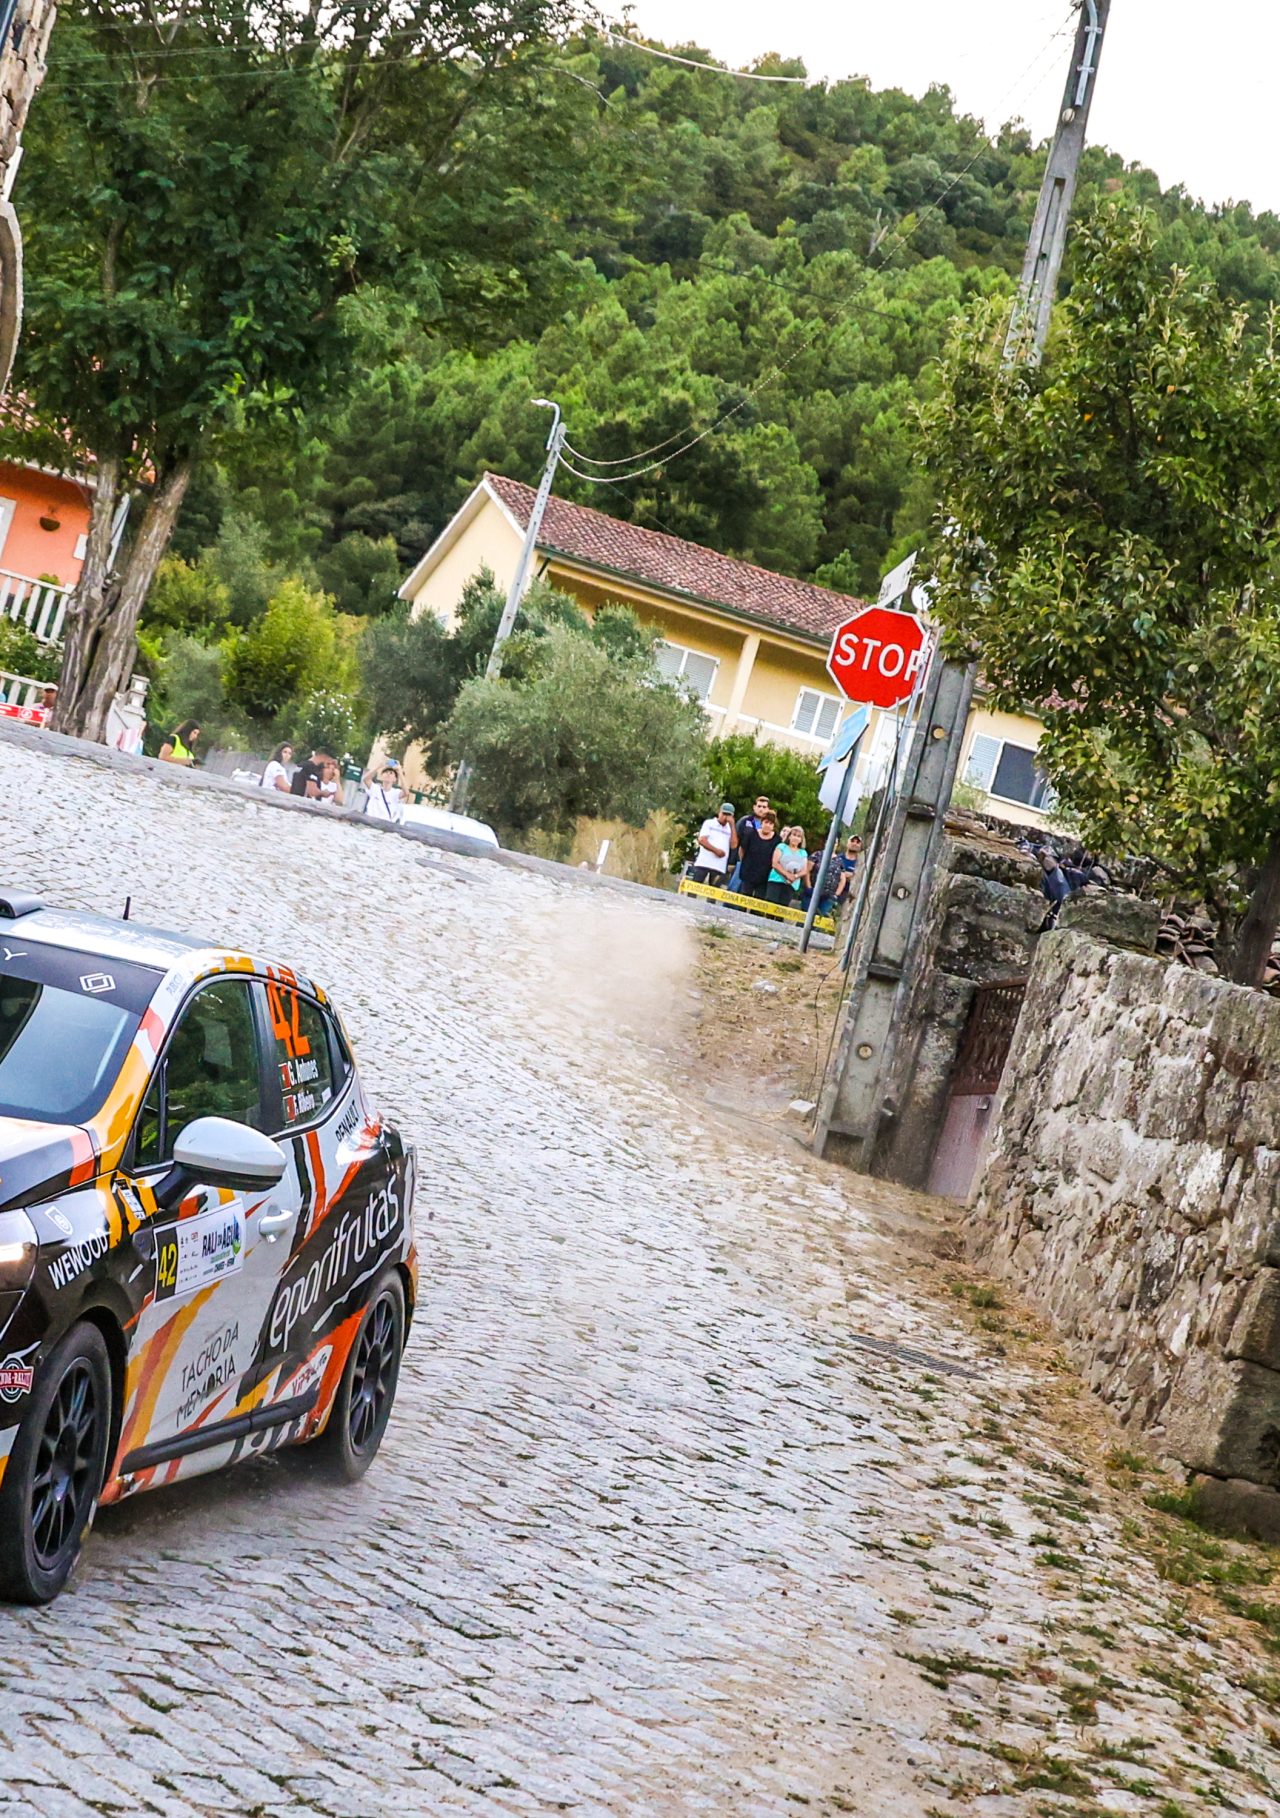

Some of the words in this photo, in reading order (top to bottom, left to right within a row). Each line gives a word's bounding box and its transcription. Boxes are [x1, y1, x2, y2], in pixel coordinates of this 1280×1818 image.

[266, 966, 311, 1058] 42
[48, 1230, 109, 1291] WEWOOD
[158, 1242, 177, 1288] 42
[270, 1173, 400, 1353] eporifrutas
[182, 1336, 222, 1393] TACHO
[223, 1321, 239, 1354] DA
